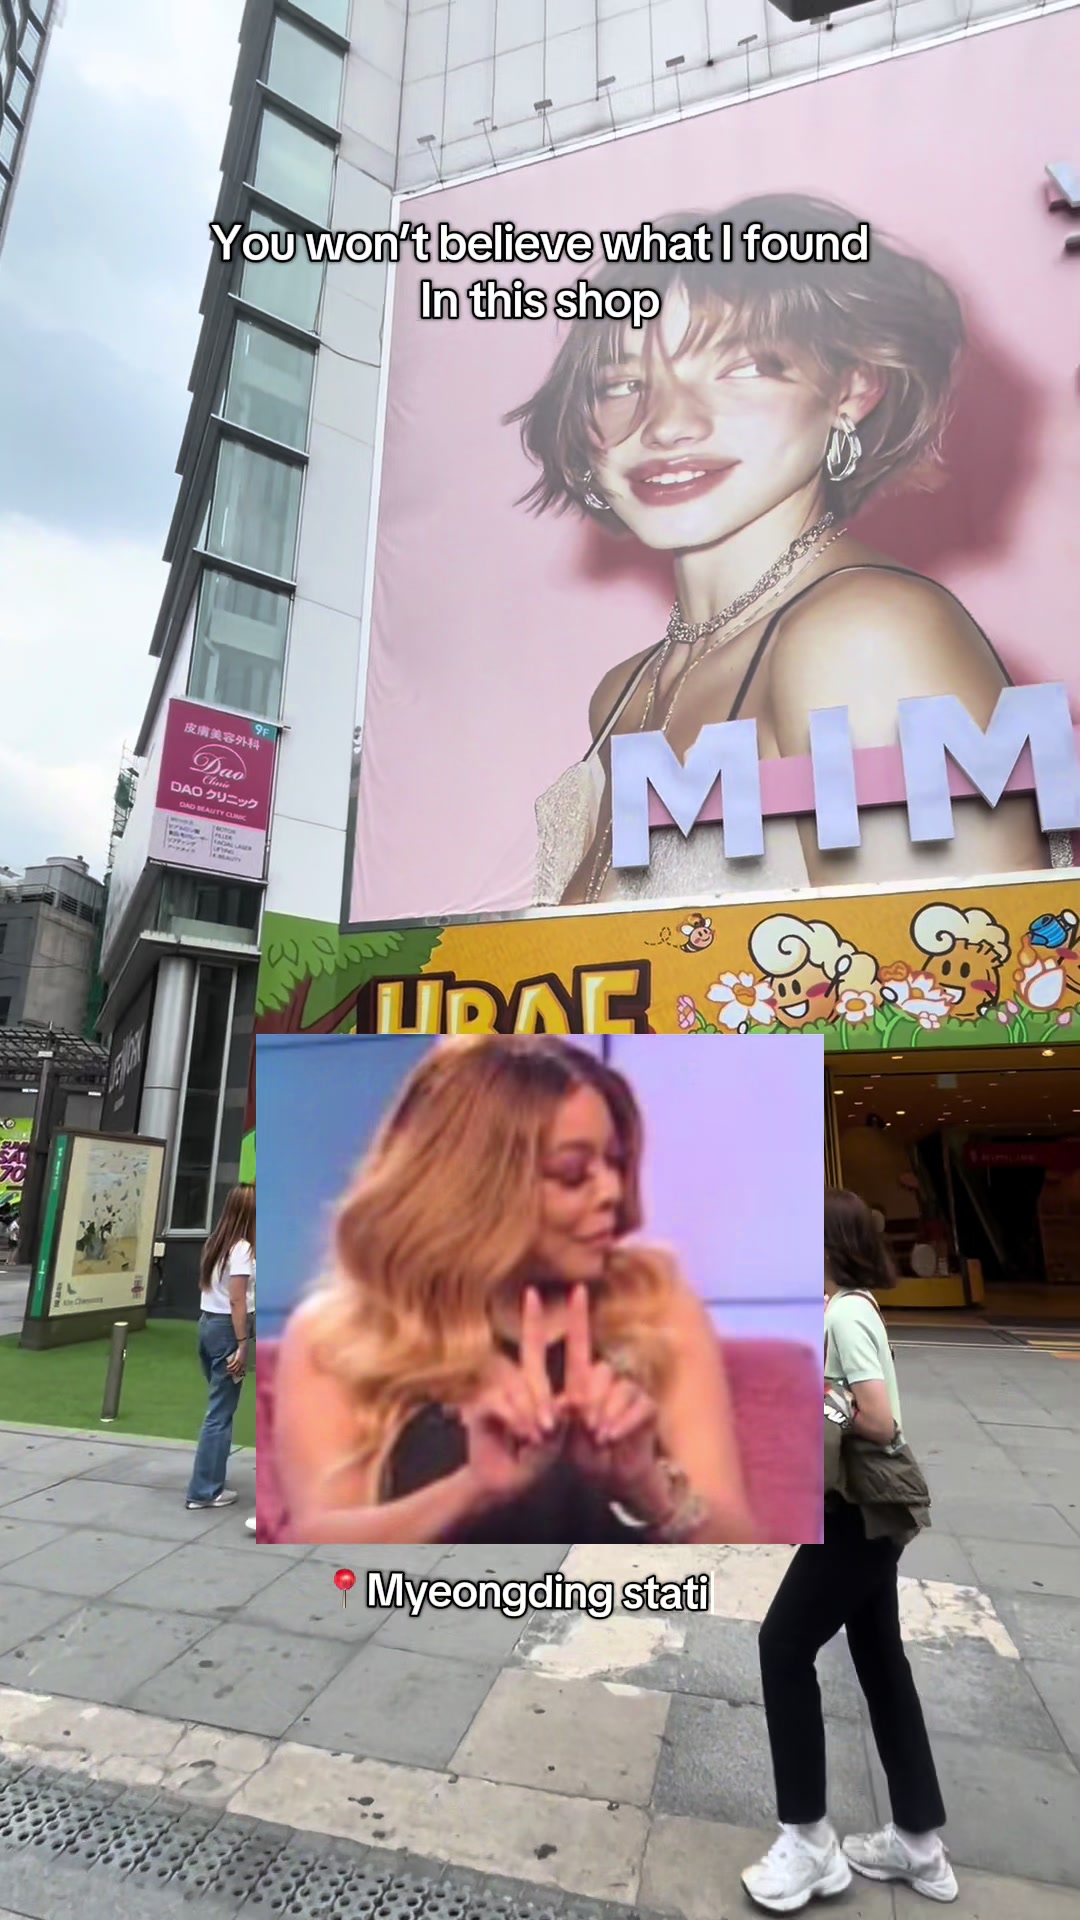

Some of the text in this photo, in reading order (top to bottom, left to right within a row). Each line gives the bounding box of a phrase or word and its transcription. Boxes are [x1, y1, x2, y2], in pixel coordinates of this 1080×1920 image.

[184, 722, 260, 750] 皮膚美容外科
[254, 724, 270, 737] 9F
[189, 751, 246, 780] Dao
[170, 780, 259, 809] DAO クリニック
[179, 801, 247, 821] DAO BEAUTY CLINIC
